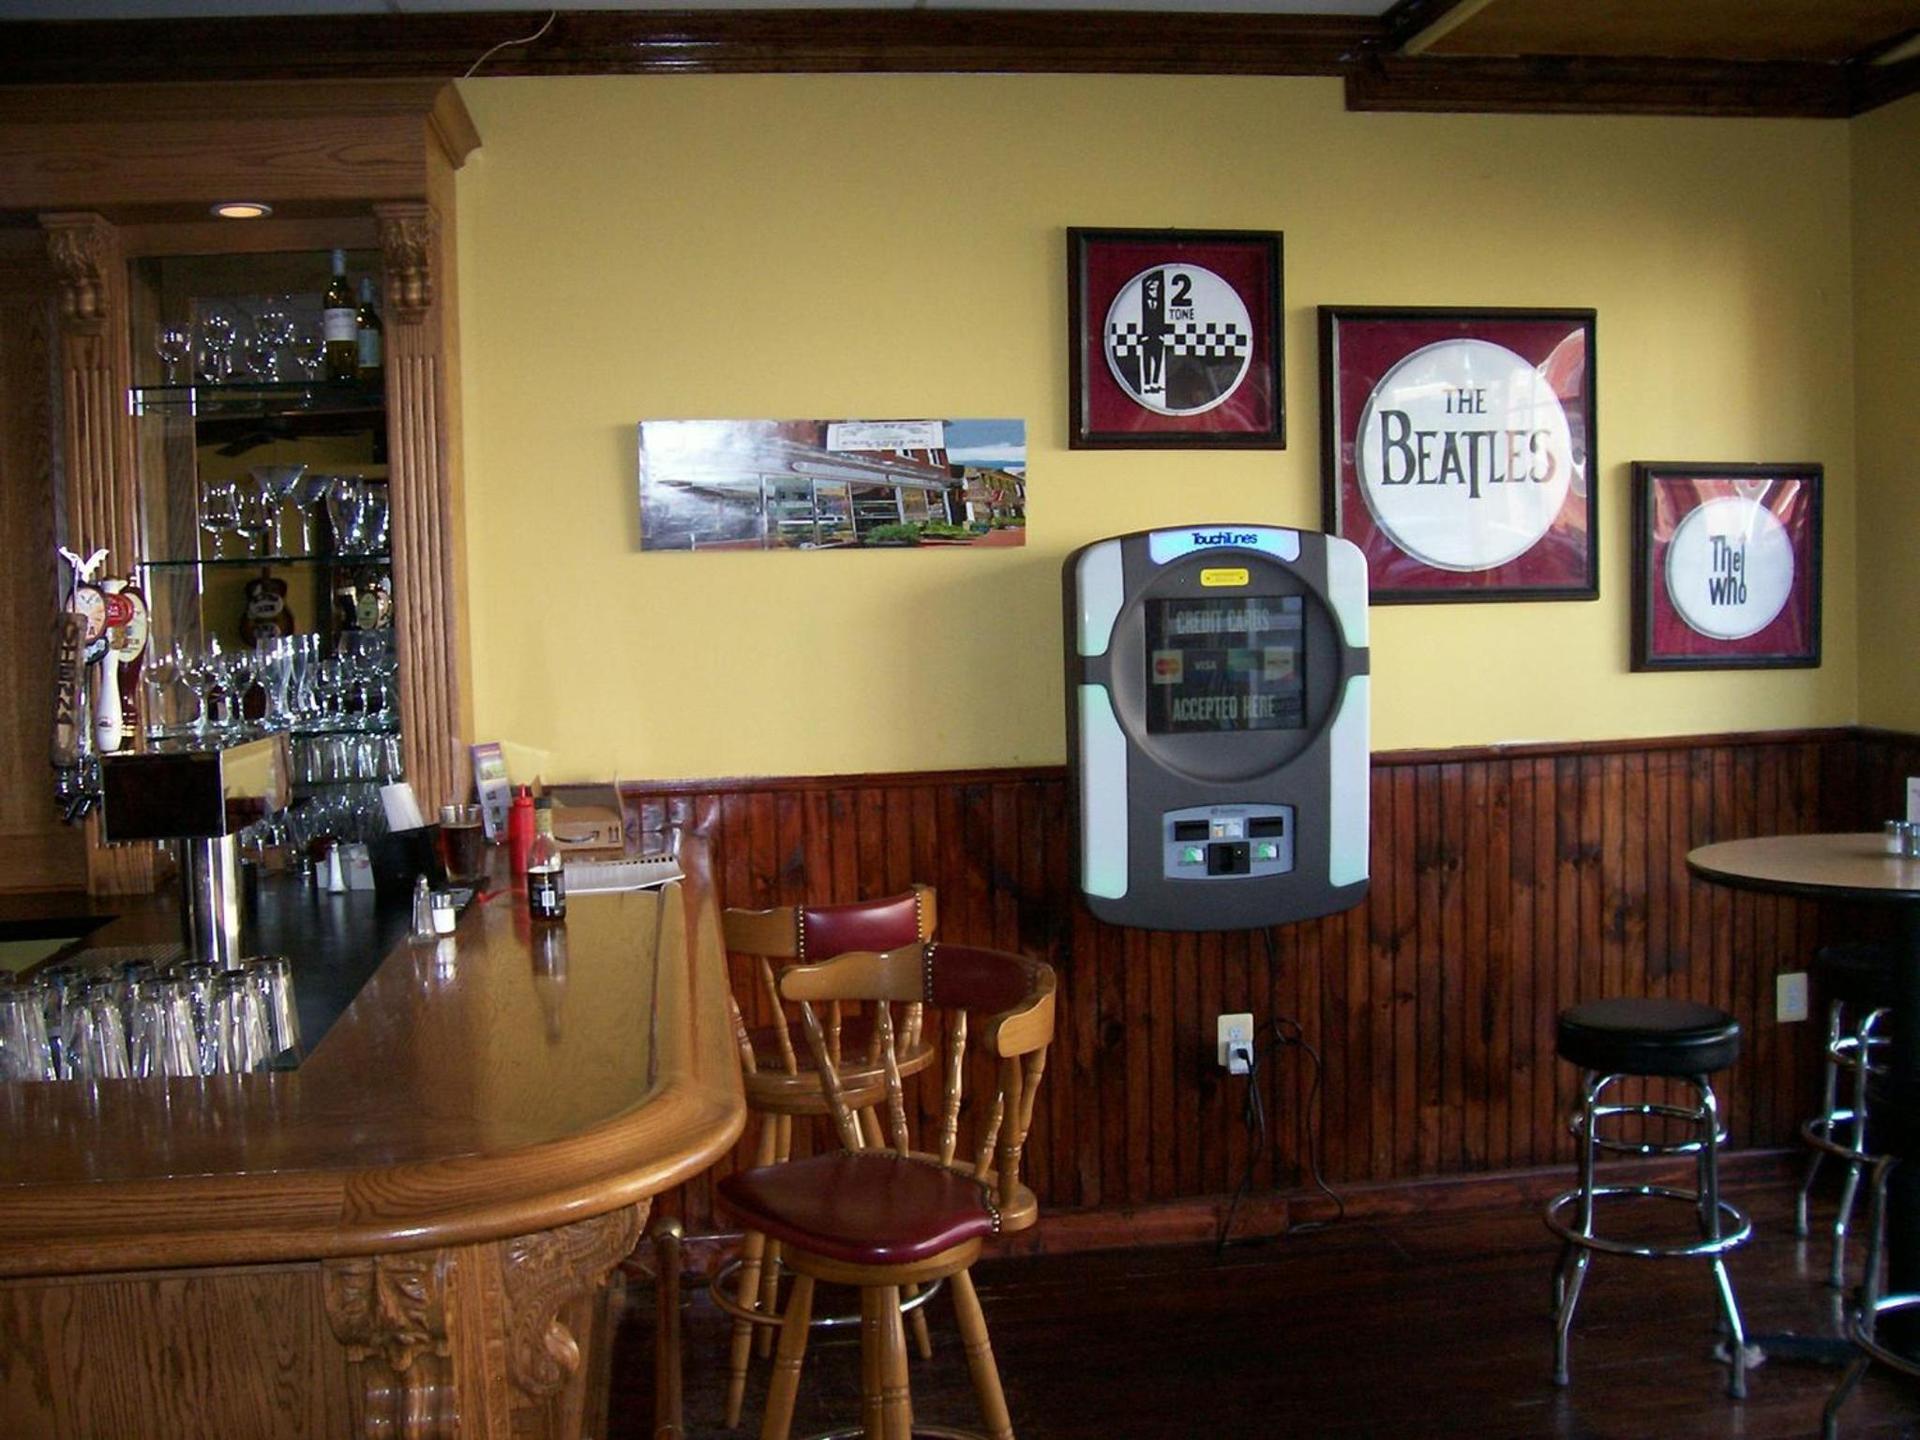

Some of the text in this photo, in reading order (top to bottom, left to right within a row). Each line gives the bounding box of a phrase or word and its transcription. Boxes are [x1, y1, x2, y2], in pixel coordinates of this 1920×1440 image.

[1171, 273, 1193, 307] 2
[1169, 308, 1195, 321] TONE
[1443, 388, 1487, 414] THE
[1379, 410, 1558, 499] BEATLES
[1192, 532, 1257, 546] TouchTunes
[1709, 535, 1740, 572] The
[1177, 610, 1222, 633] CREDIT
[1227, 607, 1271, 632] CARDS
[1172, 697, 1238, 722] ACCEPTED
[1243, 695, 1276, 719] HERE
